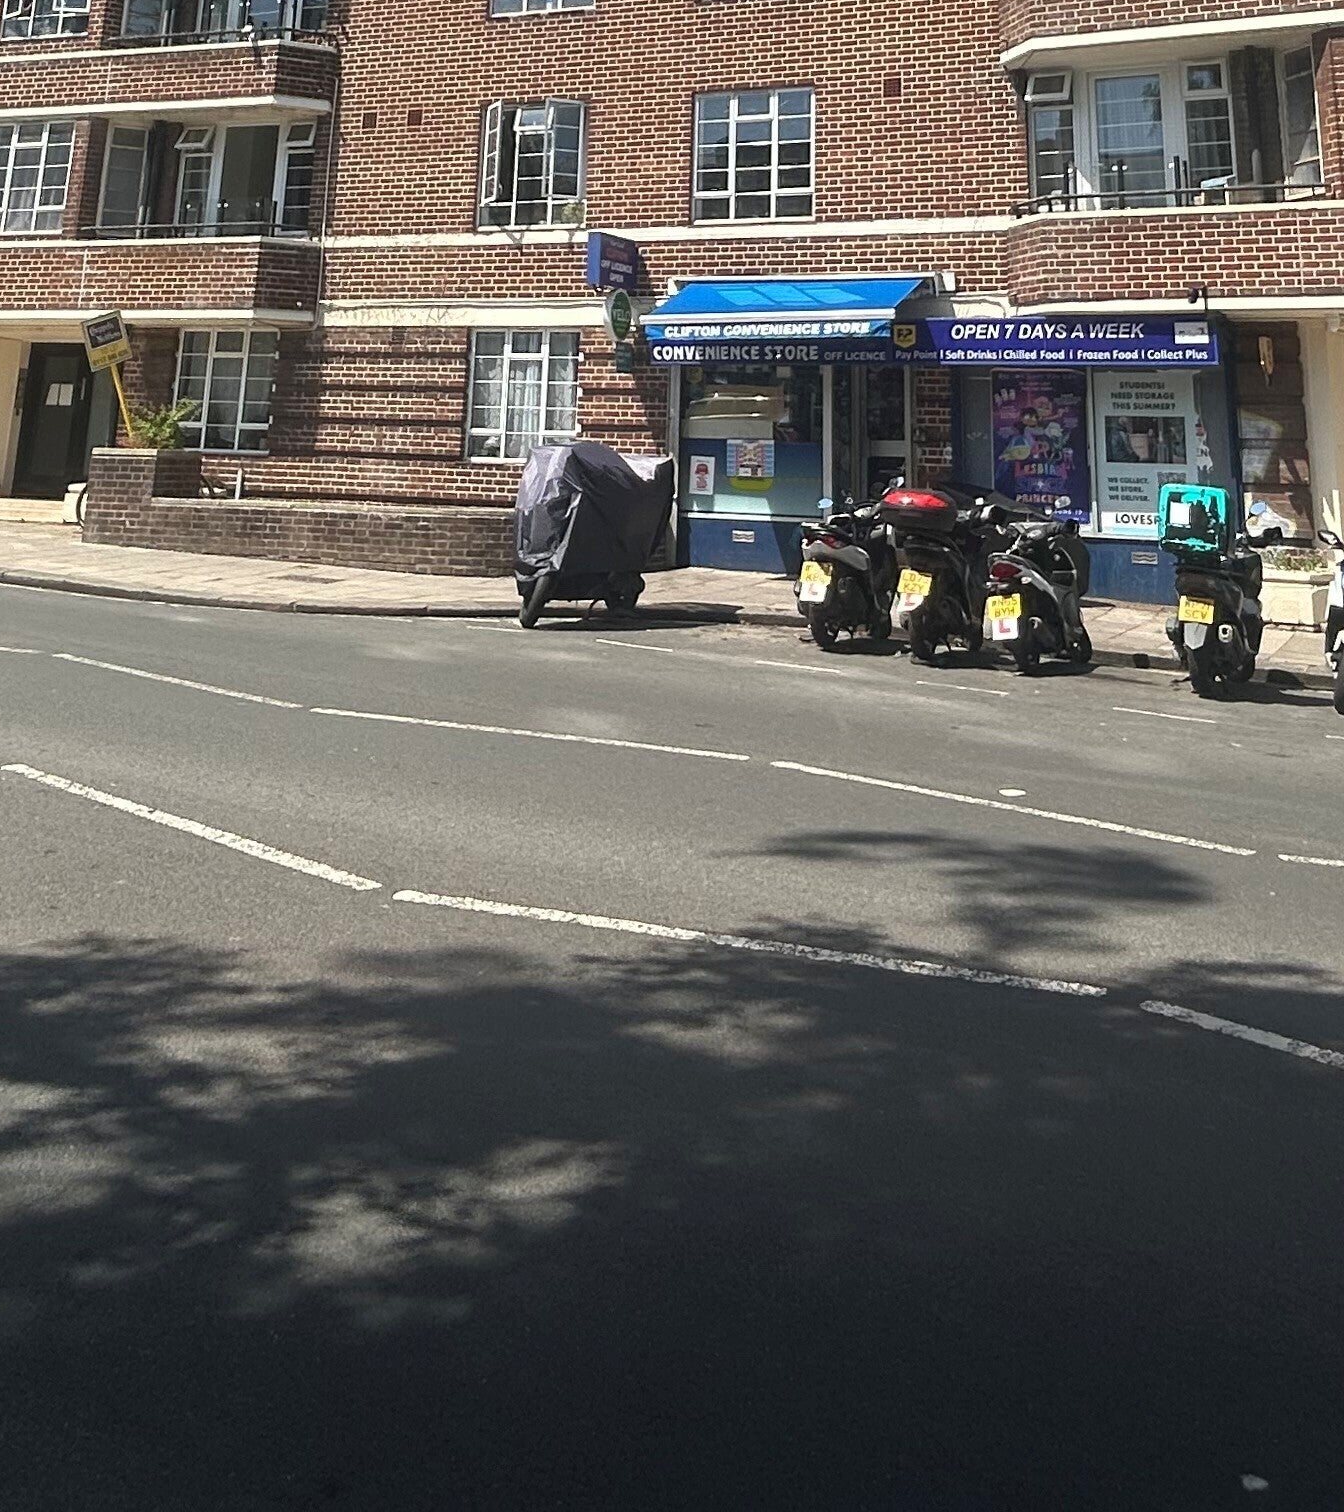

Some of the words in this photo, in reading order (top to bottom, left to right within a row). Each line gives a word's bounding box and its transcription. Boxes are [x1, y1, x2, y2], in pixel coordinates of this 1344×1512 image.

[664, 325, 720, 338] CLIFTON
[723, 323, 820, 337] CONVENIENCE
[823, 321, 871, 335] STORE
[951, 323, 1000, 339] OPEN
[1004, 324, 1016, 339] 7
[1018, 323, 1067, 339] DAYS
[1070, 323, 1084, 339] A
[1088, 322, 1144, 339] WEEK
[652, 345, 760, 362] CONVENIENCE
[764, 345, 819, 361] STORE
[824, 350, 842, 361] OFF
[844, 350, 886, 361] LICENCE
[895, 349, 912, 361] Pay
[913, 349, 937, 360] Point
[946, 349, 965, 360] Soft
[966, 349, 998, 360] Drinks
[1003, 349, 1037, 360] Chilled
[1039, 349, 1065, 360] Food
[1077, 349, 1110, 360] Frozen
[1112, 349, 1139, 360] Food
[1147, 349, 1183, 360] Collect
[1185, 349, 1208, 360] Plus
[1110, 392, 1133, 400] NEED
[1134, 392, 1175, 400] STORAGE
[1112, 402, 1131, 410] THIS
[1133, 402, 1176, 410] SUMMER?
